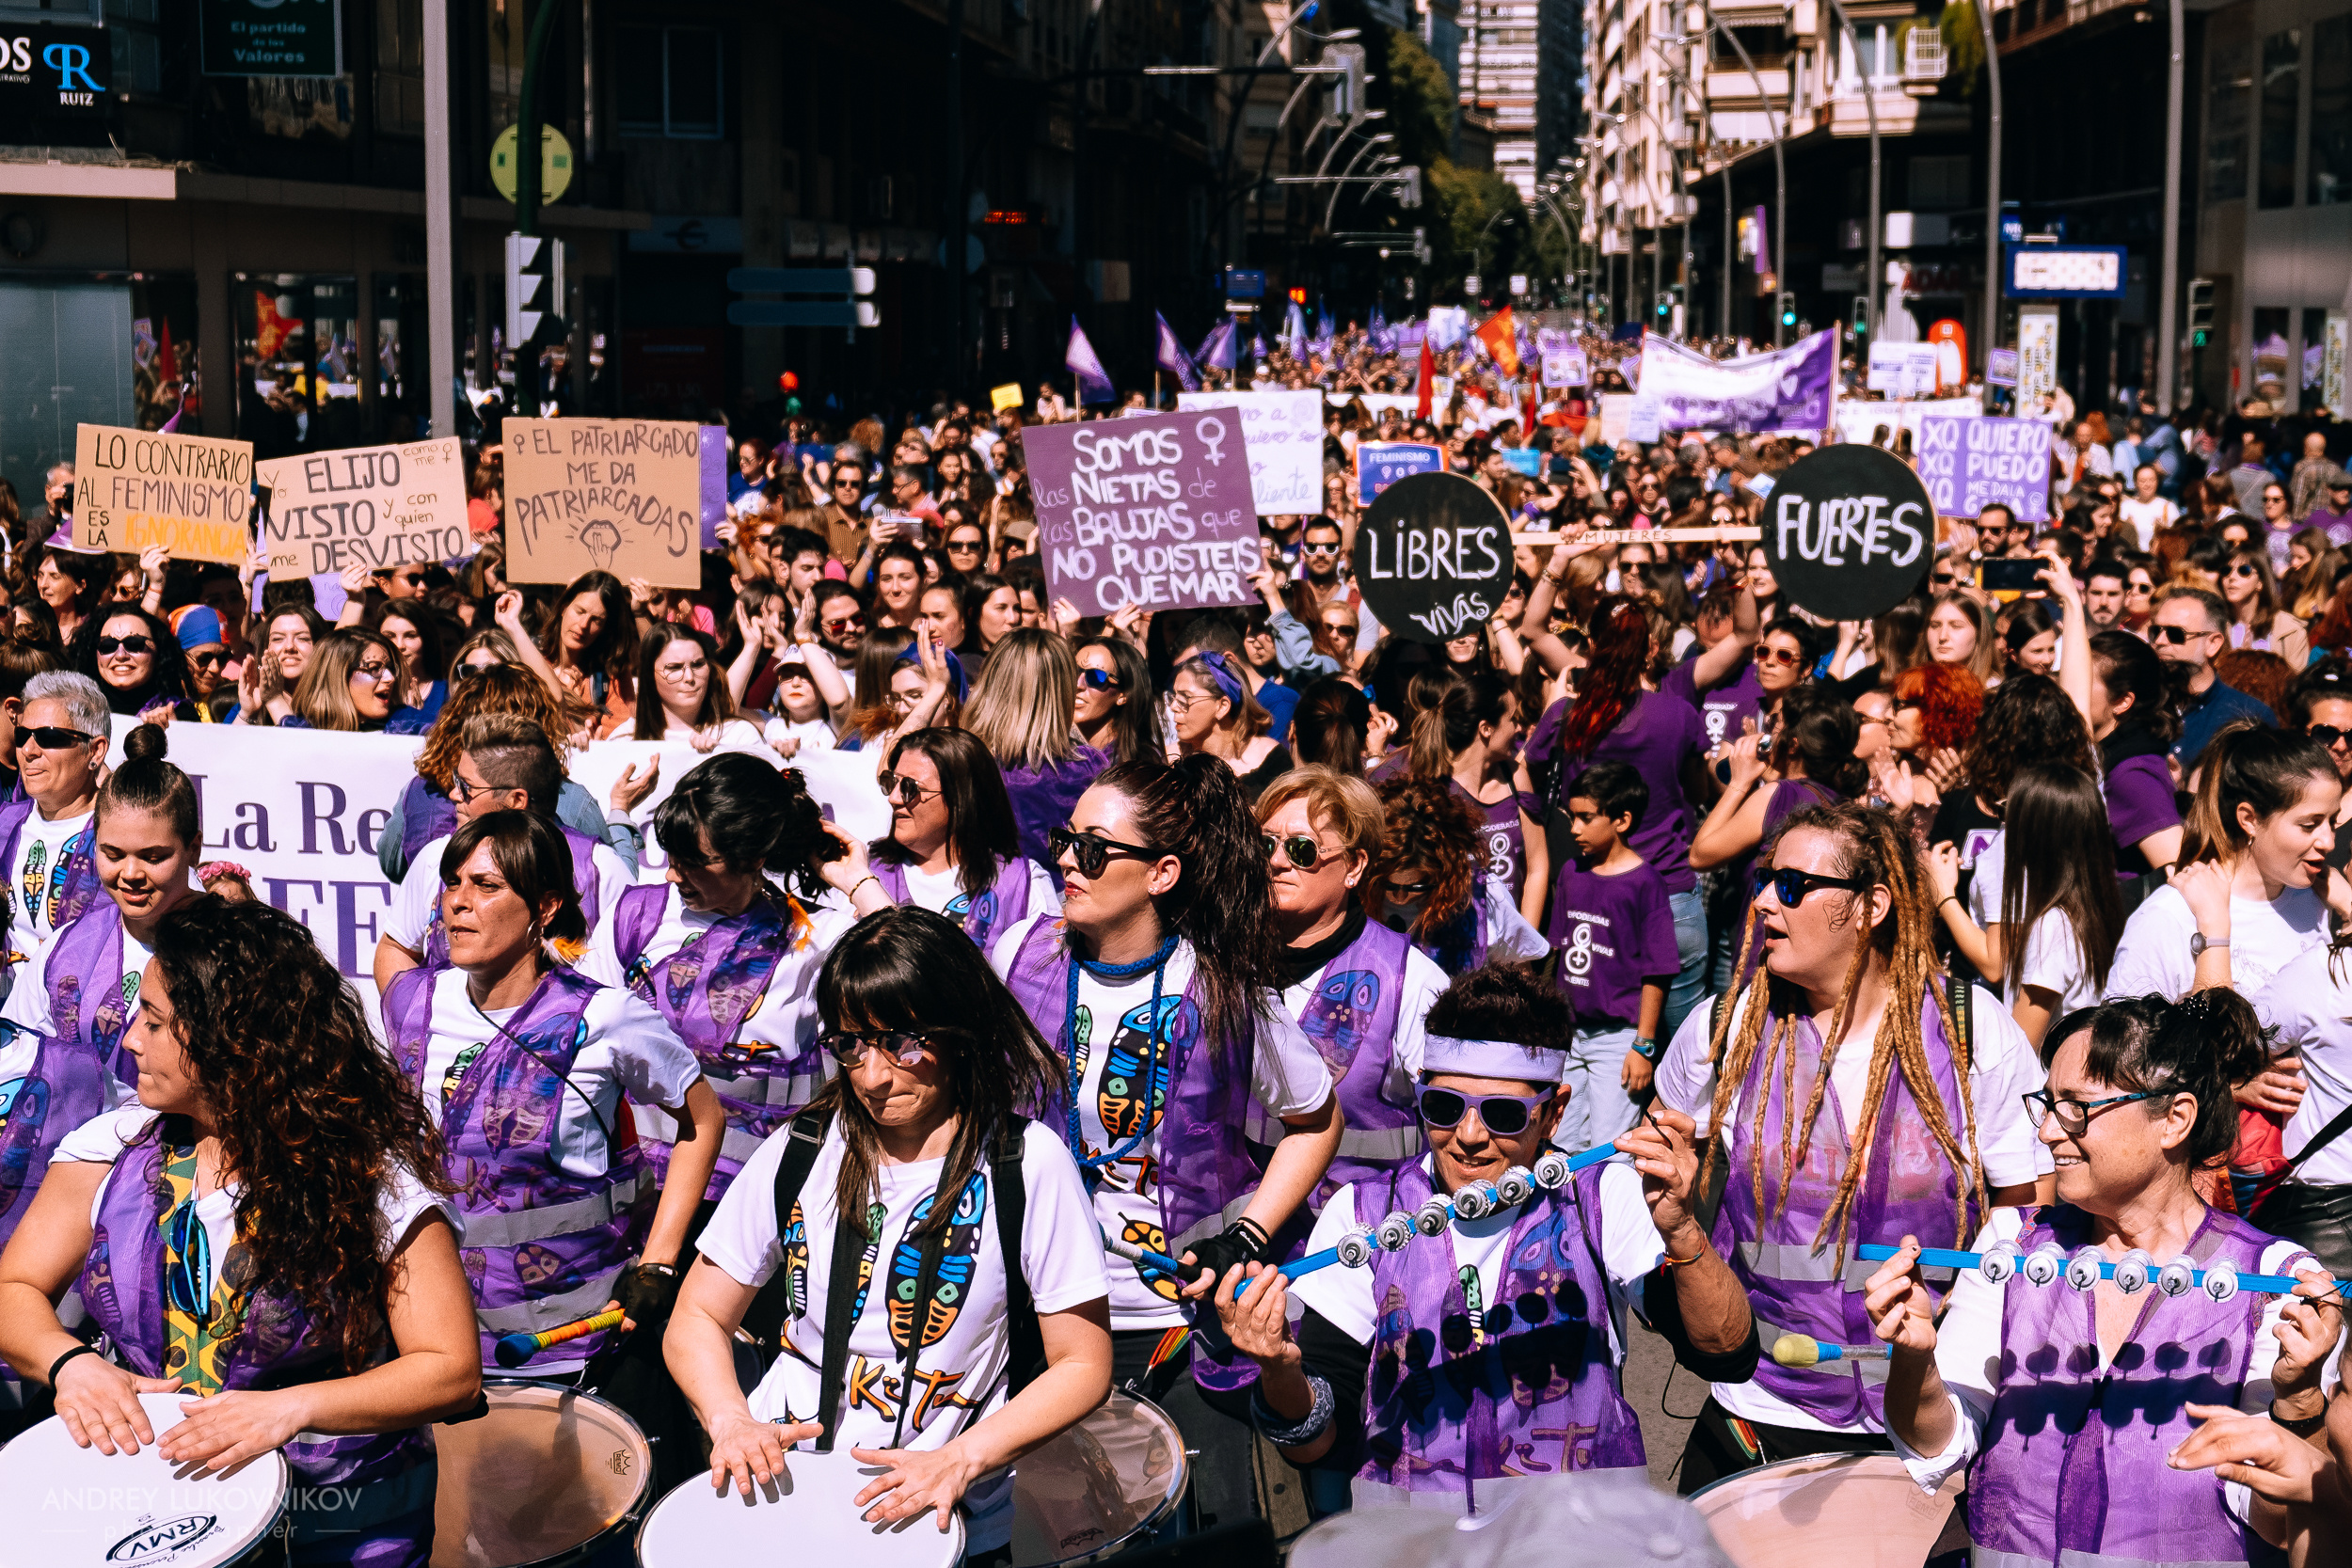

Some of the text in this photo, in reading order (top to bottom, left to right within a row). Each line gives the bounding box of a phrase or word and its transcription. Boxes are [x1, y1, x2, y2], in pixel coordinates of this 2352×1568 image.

[249, 21, 307, 36] partido
[233, 48, 306, 63] Valores
[59, 92, 94, 106] RUIZ
[532, 423, 698, 459] EL PATRIARCADO
[1073, 428, 1183, 472] SOMOS
[1923, 419, 2050, 455] XQ QUIERO
[95, 433, 249, 485] LO CONTRARIO
[263, 443, 438, 499] Yo ELIJO como
[415, 454, 436, 467] me
[566, 461, 636, 485] ME DA
[1369, 451, 1431, 465] FEMINISMO
[1921, 451, 2046, 483] XQ PUEDO
[77, 476, 245, 522] AL FEMINISMO
[1033, 478, 1071, 508] las
[1071, 468, 1182, 506] NIETAS
[1187, 467, 1218, 499] de
[1256, 464, 1313, 505] liente
[87, 510, 110, 527] ES
[87, 513, 247, 558] LA IGNORANCIA
[267, 499, 375, 542] VISTO
[406, 492, 438, 505] con
[394, 510, 435, 531] quien
[515, 485, 694, 558] PATRIARCADAS
[1040, 501, 1242, 547] las BRUJAS que
[1585, 530, 1674, 543] MUJERES
[1776, 494, 1925, 566] FUERTES
[270, 525, 464, 576] me DESVISTO
[1052, 535, 1262, 585] NO PUDISTEIS
[1096, 571, 1247, 612] QUEMAR
[186, 774, 391, 856] La Re
[1591, 942, 1616, 958] VIVAS
[129, 1517, 198, 1559] RMV
